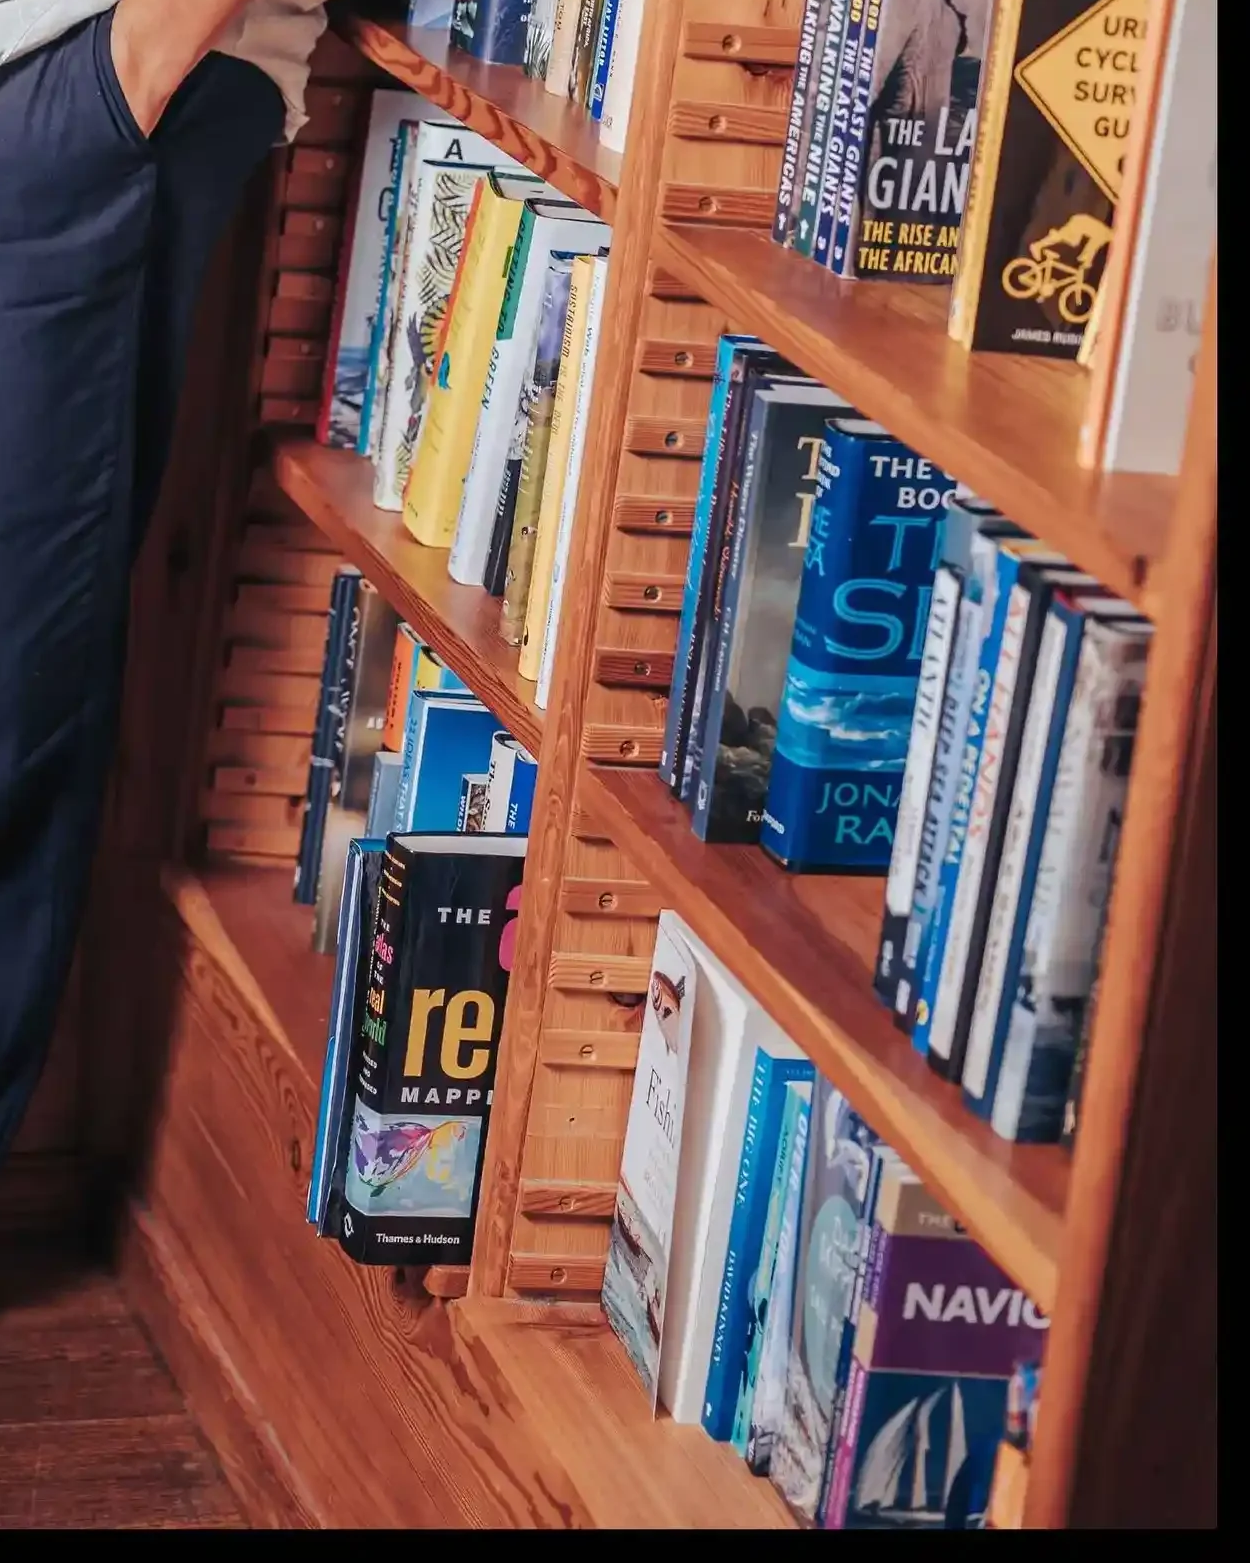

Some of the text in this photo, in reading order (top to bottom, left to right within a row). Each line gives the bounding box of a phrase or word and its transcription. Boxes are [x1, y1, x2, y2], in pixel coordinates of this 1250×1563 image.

[841, 37, 859, 73] THE
[857, 47, 875, 81] THE
[796, 66, 809, 91] THE
[832, 77, 855, 129] LAST
[849, 86, 871, 138] LAST
[777, 91, 804, 207] AMERICAS
[814, 114, 827, 142] THE
[887, 117, 924, 147] THE
[801, 143, 824, 207] NILE
[819, 136, 845, 217] GIANTS
[836, 145, 860, 226] GIANTS
[862, 219, 933, 249] THE RISE
[858, 247, 889, 272] THE
[480, 218, 529, 412] GETTING TO GREEN
[560, 283, 579, 359] SUSTAINISM
[869, 454, 932, 480] THE
[969, 668, 991, 715] ON
[966, 716, 981, 740] A
[397, 738, 415, 817] IDEAS THAT
[927, 759, 949, 806] SEA
[507, 802, 519, 829] THE
[438, 907, 491, 926] THE
[403, 988, 495, 1080] re
[742, 1115, 760, 1156] BIG
[376, 1232, 460, 1246] Thames Hudson
[722, 1249, 738, 1300] DAVID
